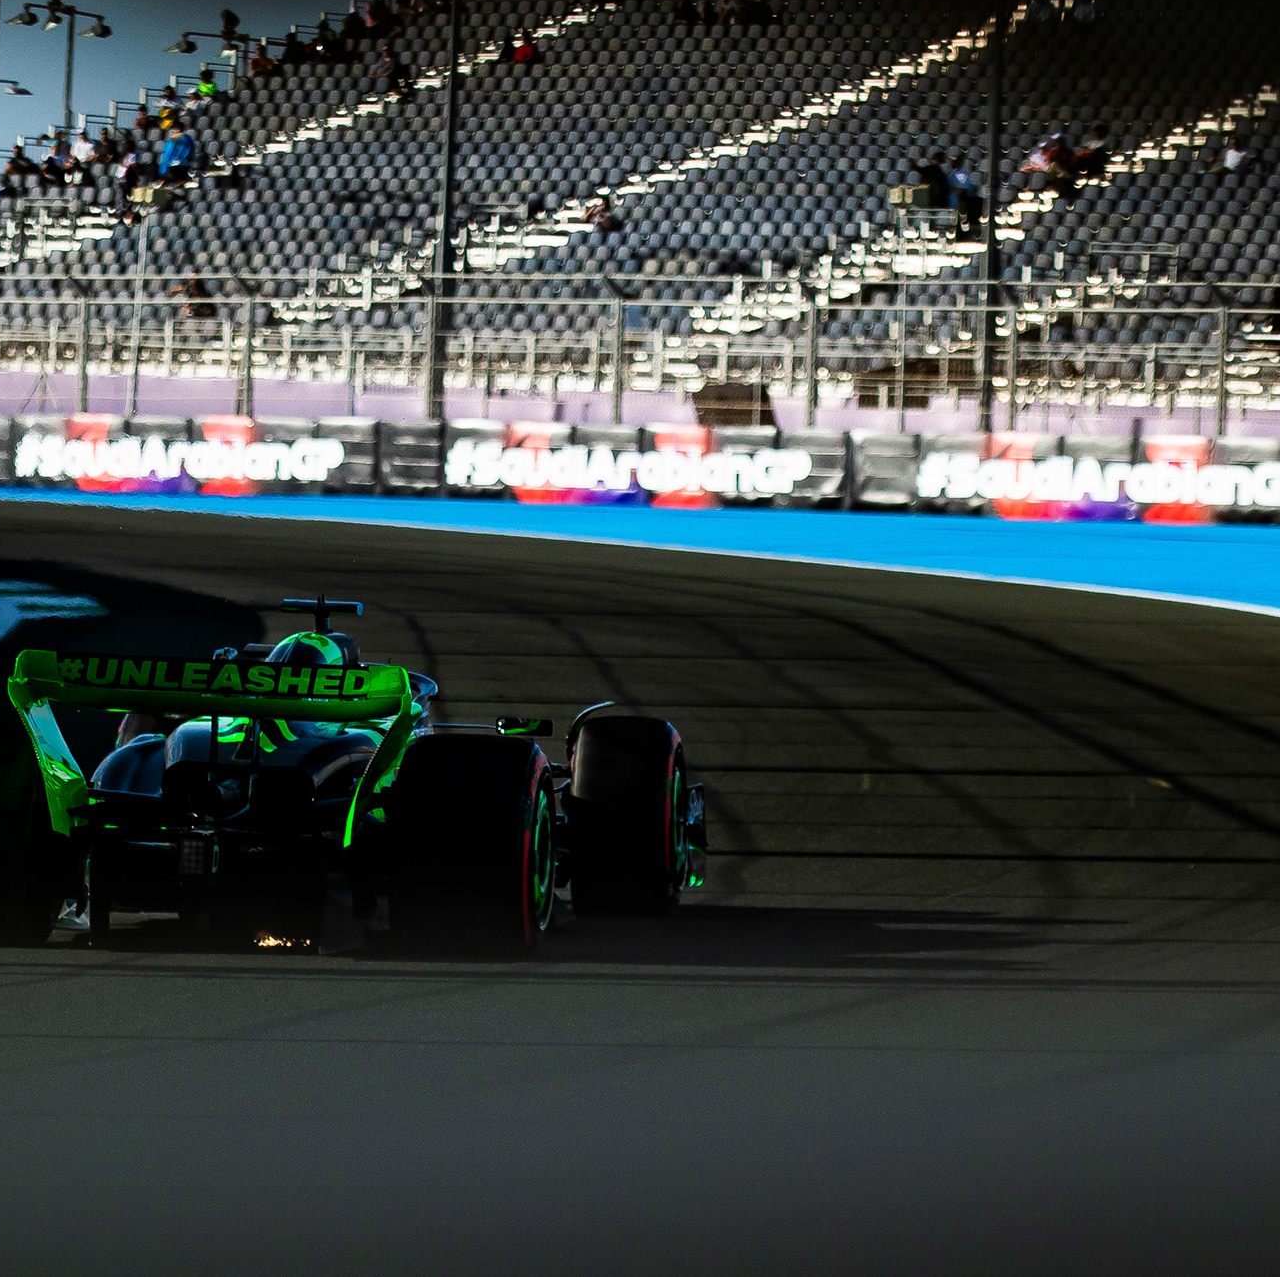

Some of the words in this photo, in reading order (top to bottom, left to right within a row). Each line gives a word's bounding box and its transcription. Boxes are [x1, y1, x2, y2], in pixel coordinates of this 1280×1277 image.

[14, 433, 345, 482] #SaudiArabianGP
[446, 438, 813, 494] #SaudiArabianGP
[59, 657, 370, 696] #UNLEASHED
